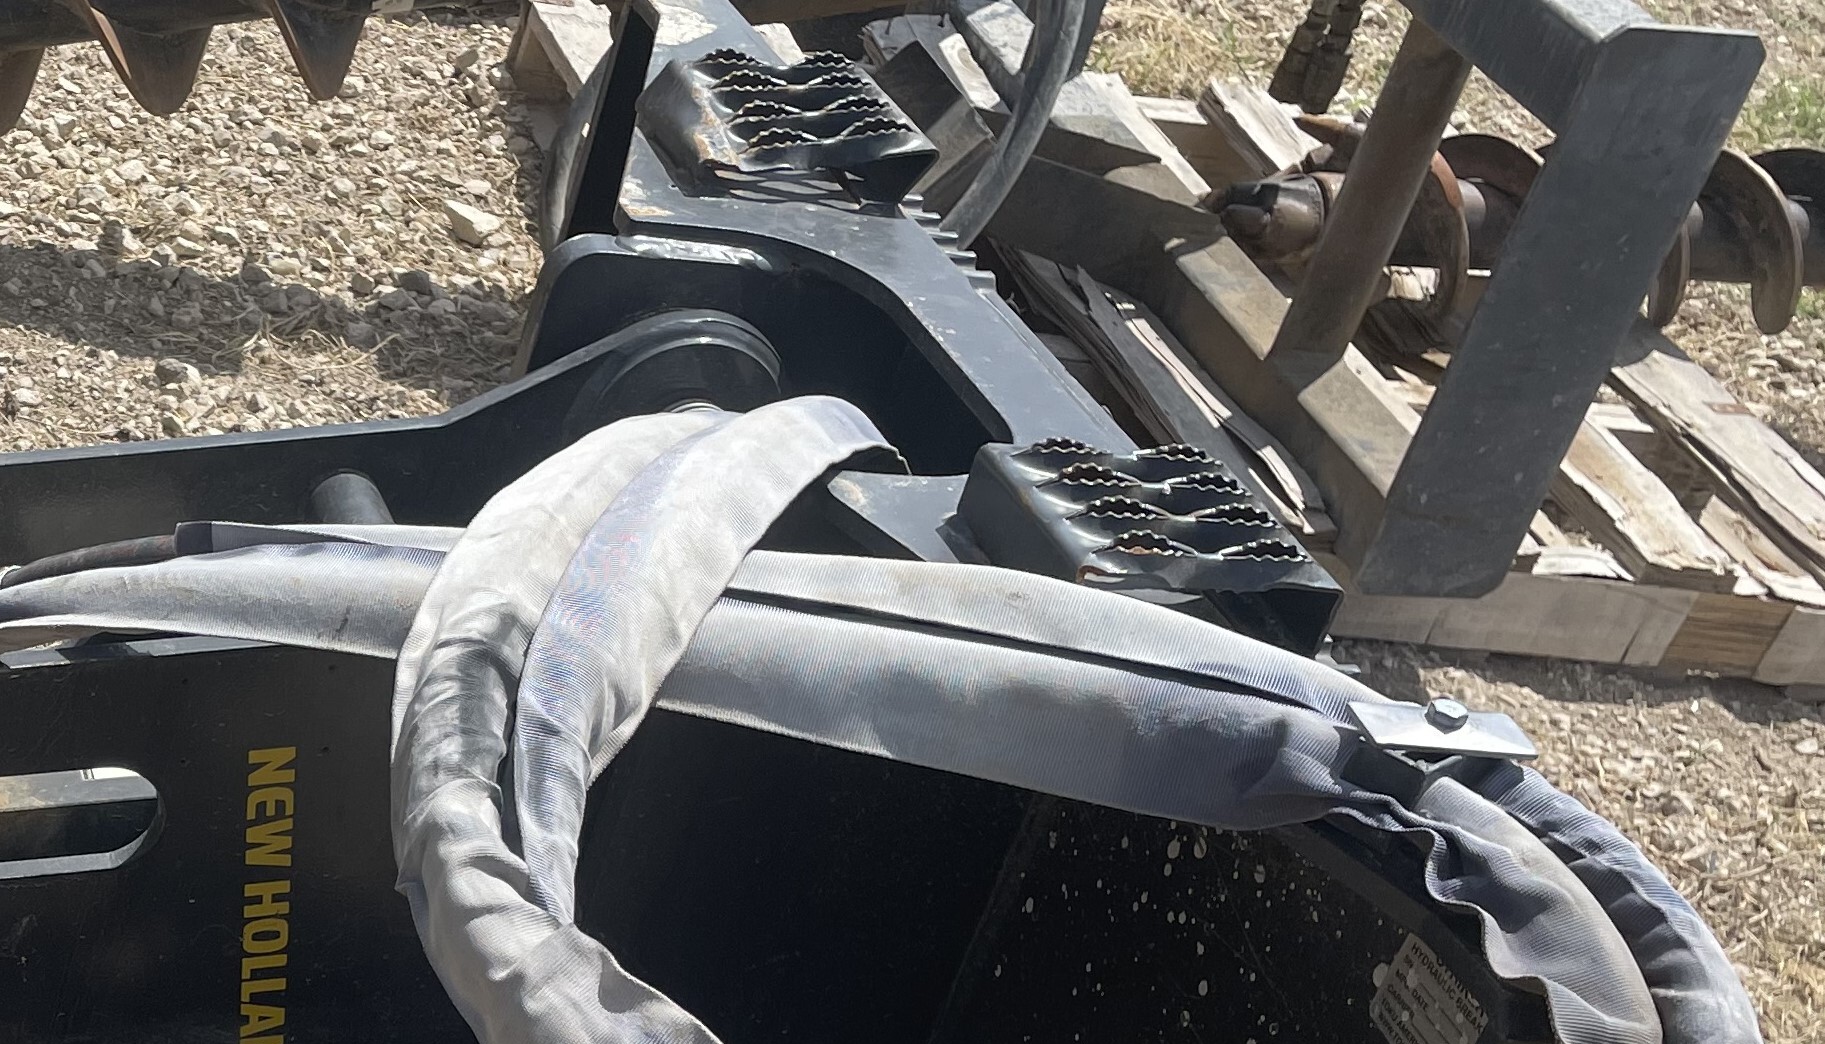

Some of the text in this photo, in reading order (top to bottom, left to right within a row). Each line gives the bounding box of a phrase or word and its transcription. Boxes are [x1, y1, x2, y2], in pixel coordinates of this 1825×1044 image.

[244, 746, 297, 867] NEW
[1411, 942, 1456, 1000] HYDRAULIC
[1411, 989, 1428, 1011] DATE
